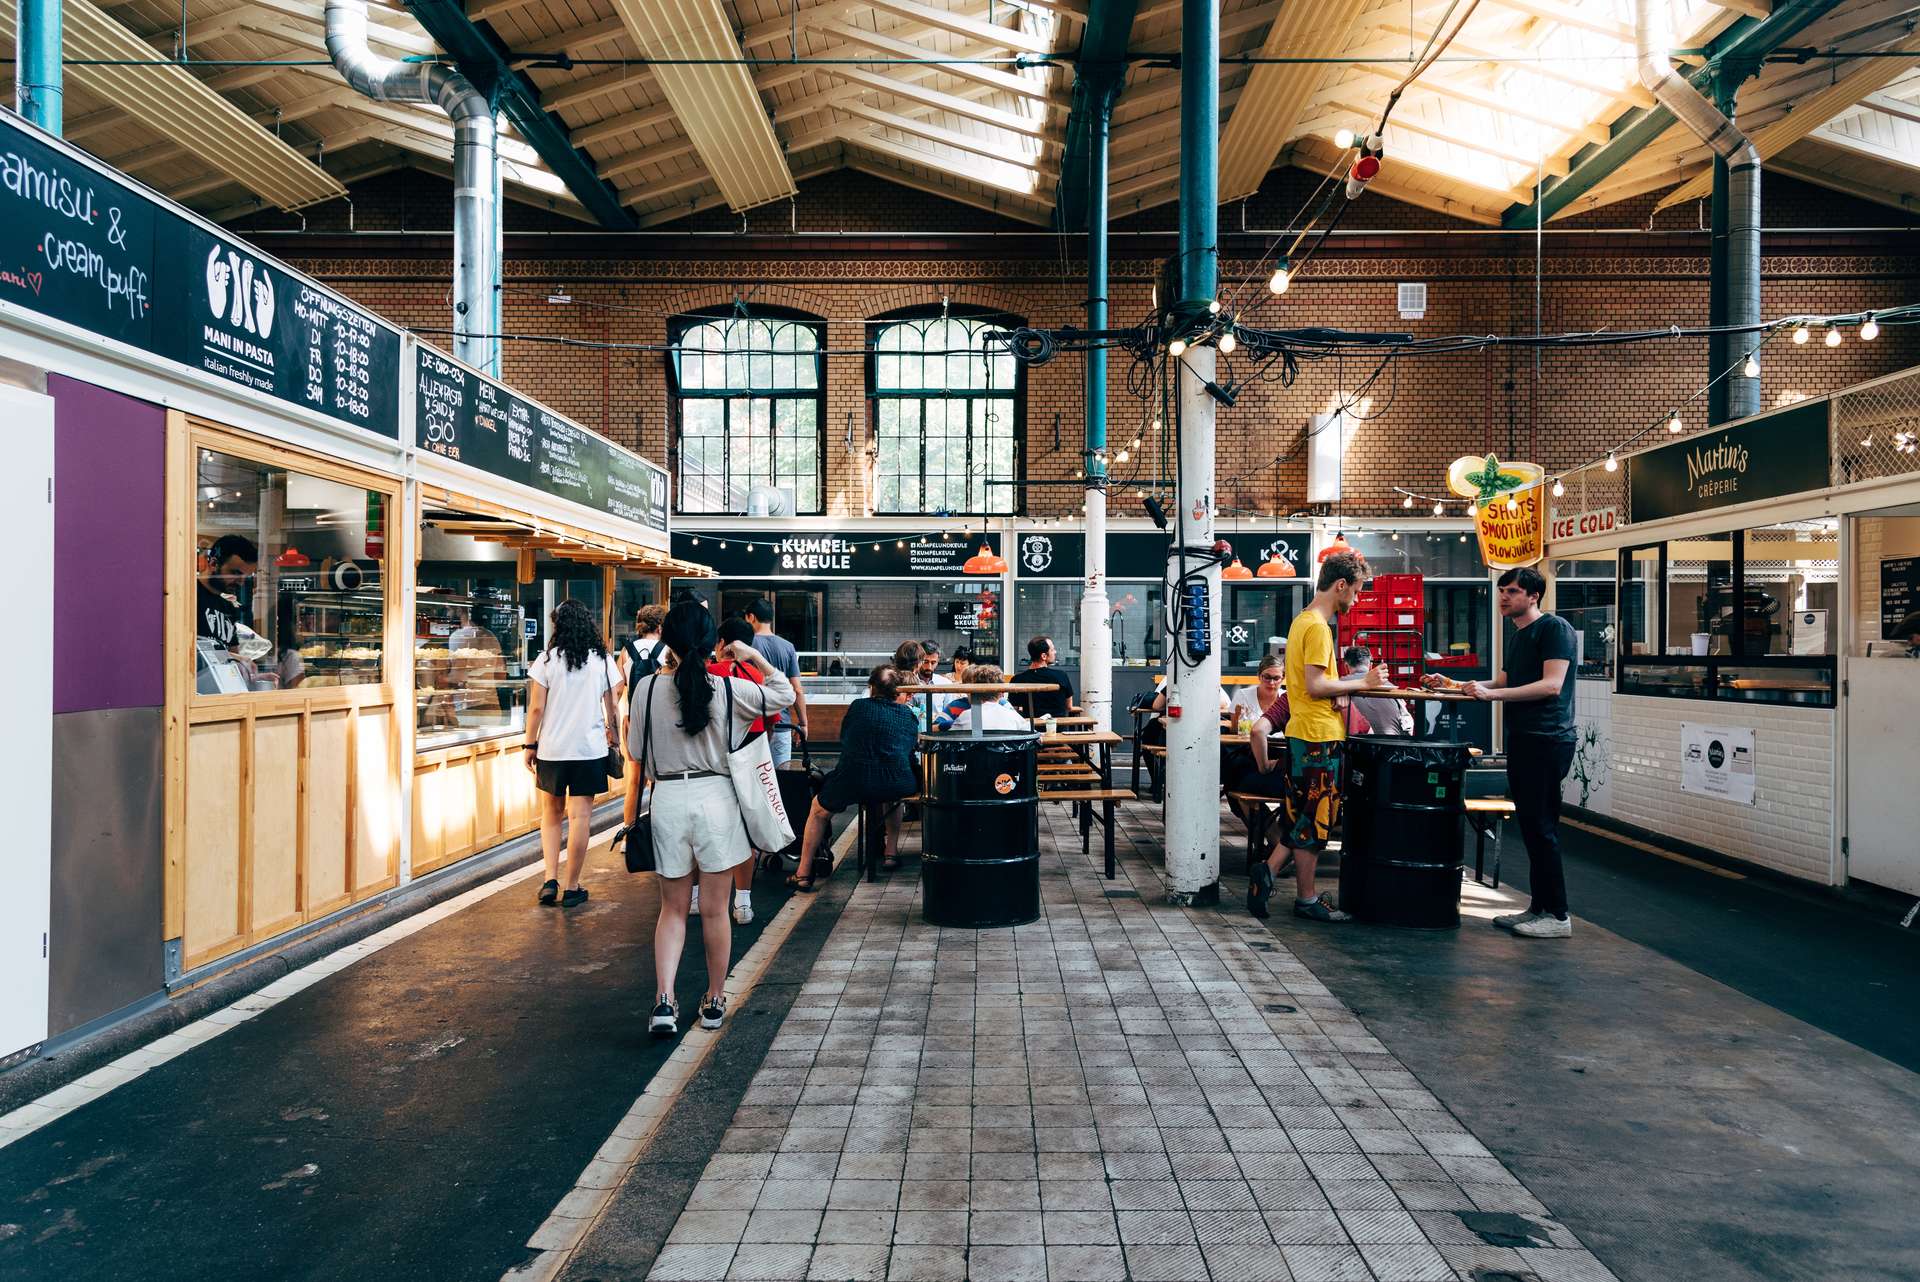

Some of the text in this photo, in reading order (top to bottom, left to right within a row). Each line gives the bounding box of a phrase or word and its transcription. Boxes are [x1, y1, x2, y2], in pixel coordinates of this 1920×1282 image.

[108, 207, 126, 251] &
[301, 285, 376, 337] ÖFFNUNGSZEITEN
[204, 325, 274, 367] MANI IN PASTA
[311, 328, 321, 345] DI
[309, 347, 322, 365] FR
[204, 356, 274, 391] italian freshly made
[308, 364, 322, 383] DO
[426, 414, 455, 442] BIO
[432, 442, 447, 455] OHNE
[1686, 435, 1748, 492] Martin's
[1698, 477, 1738, 498] CRÊPERIE
[1481, 516, 1538, 540] SMOOTHIES
[1552, 511, 1614, 539] ICE COLD
[782, 539, 849, 553] KUMPEL
[782, 554, 851, 569] & KEULE
